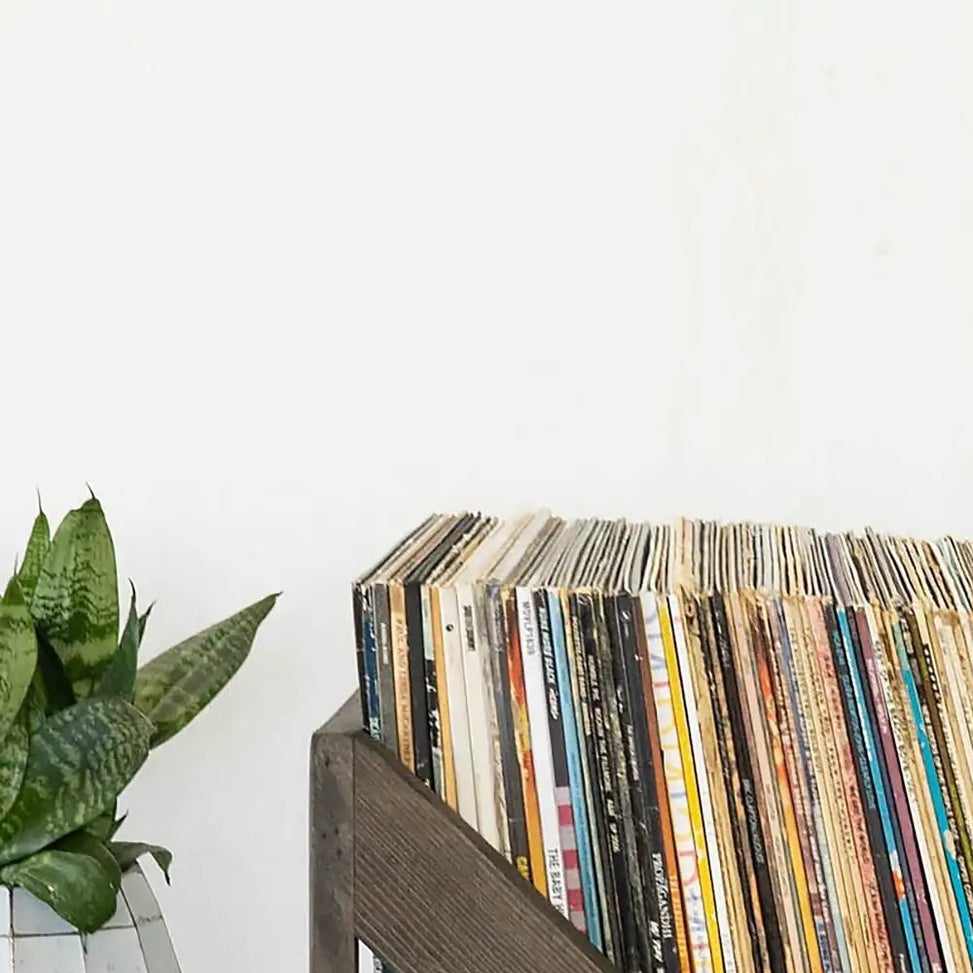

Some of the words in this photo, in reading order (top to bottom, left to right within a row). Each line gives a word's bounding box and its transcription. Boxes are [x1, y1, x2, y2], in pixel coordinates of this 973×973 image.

[544, 656, 555, 684] BLACK
[600, 755, 611, 792] FILLMORE
[548, 848, 558, 869] THE
[550, 871, 561, 900] BABY
[652, 851, 672, 938] PROPAGANDHI
